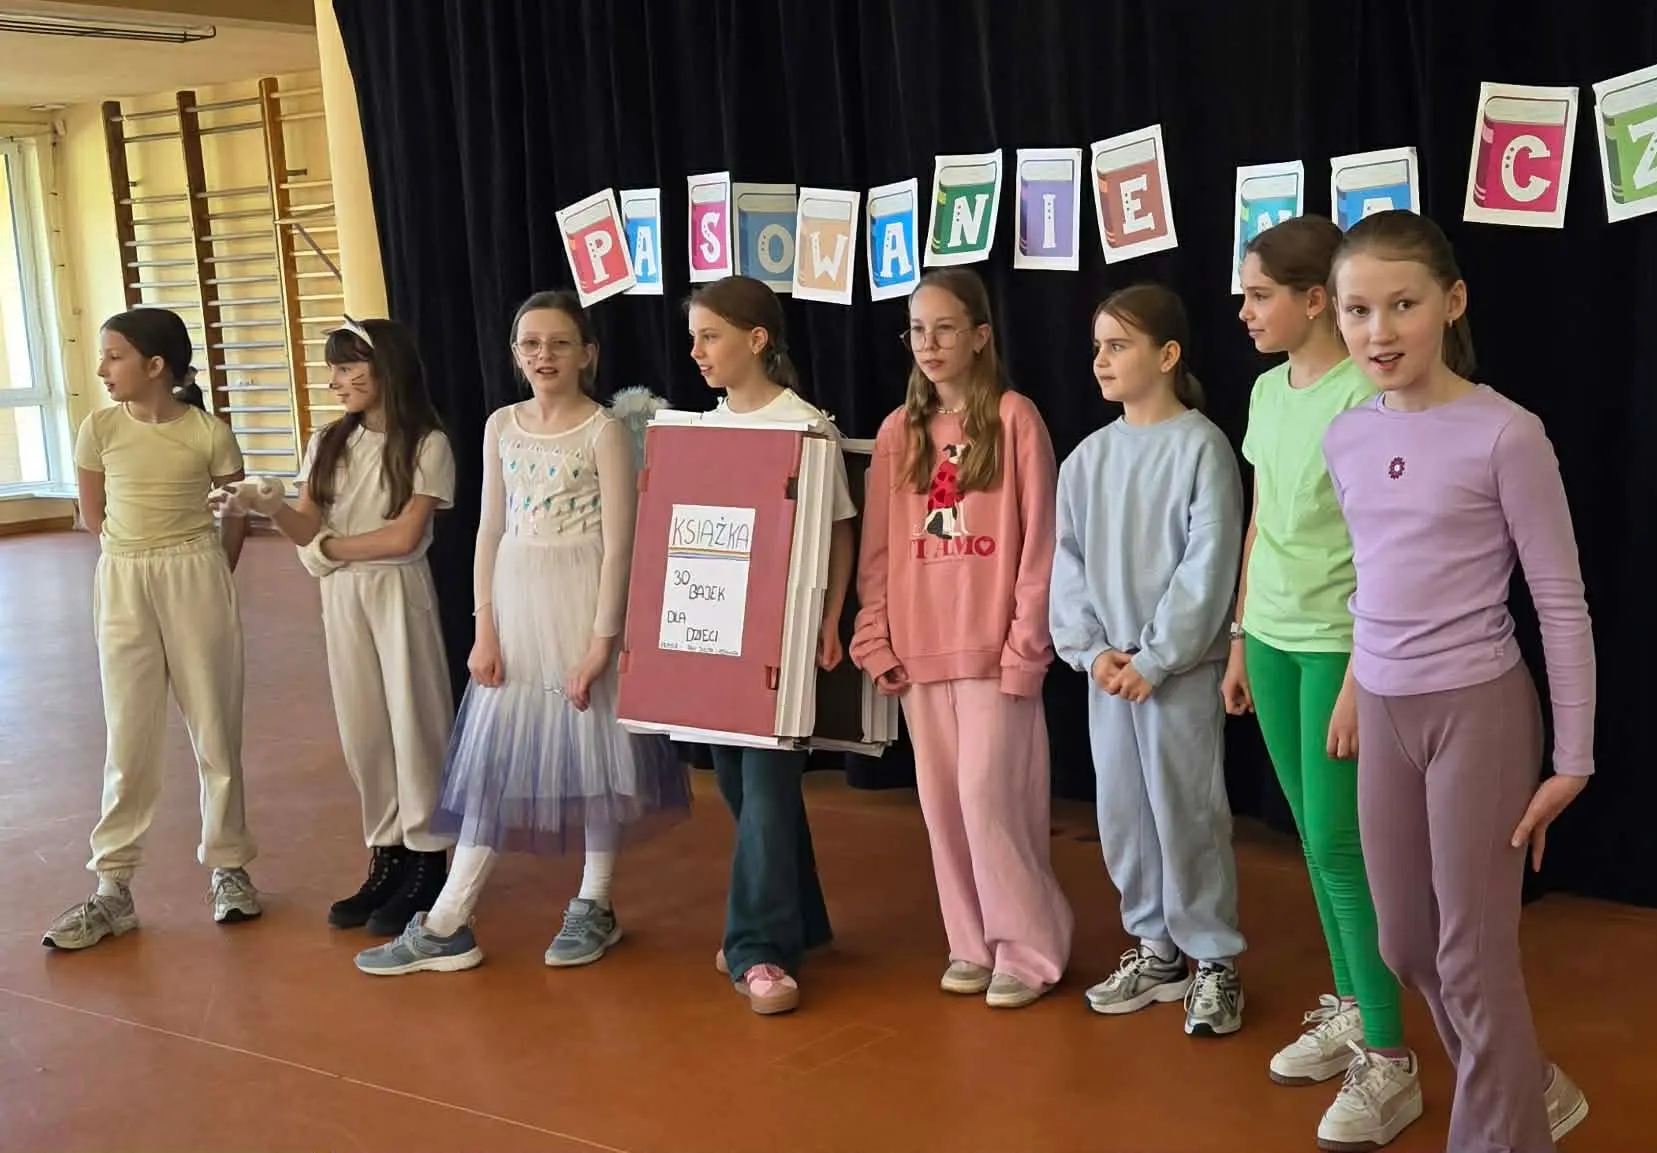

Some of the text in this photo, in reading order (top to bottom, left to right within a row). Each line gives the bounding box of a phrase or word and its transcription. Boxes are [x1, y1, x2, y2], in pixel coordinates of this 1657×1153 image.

[583, 173, 1156, 284] PASOWANIE
[671, 516, 749, 549] KSIĄŻKA
[673, 570, 691, 586] 30
[688, 584, 726, 601] BAJEK
[667, 610, 686, 624] DLA
[686, 627, 719, 643] DZIECI
